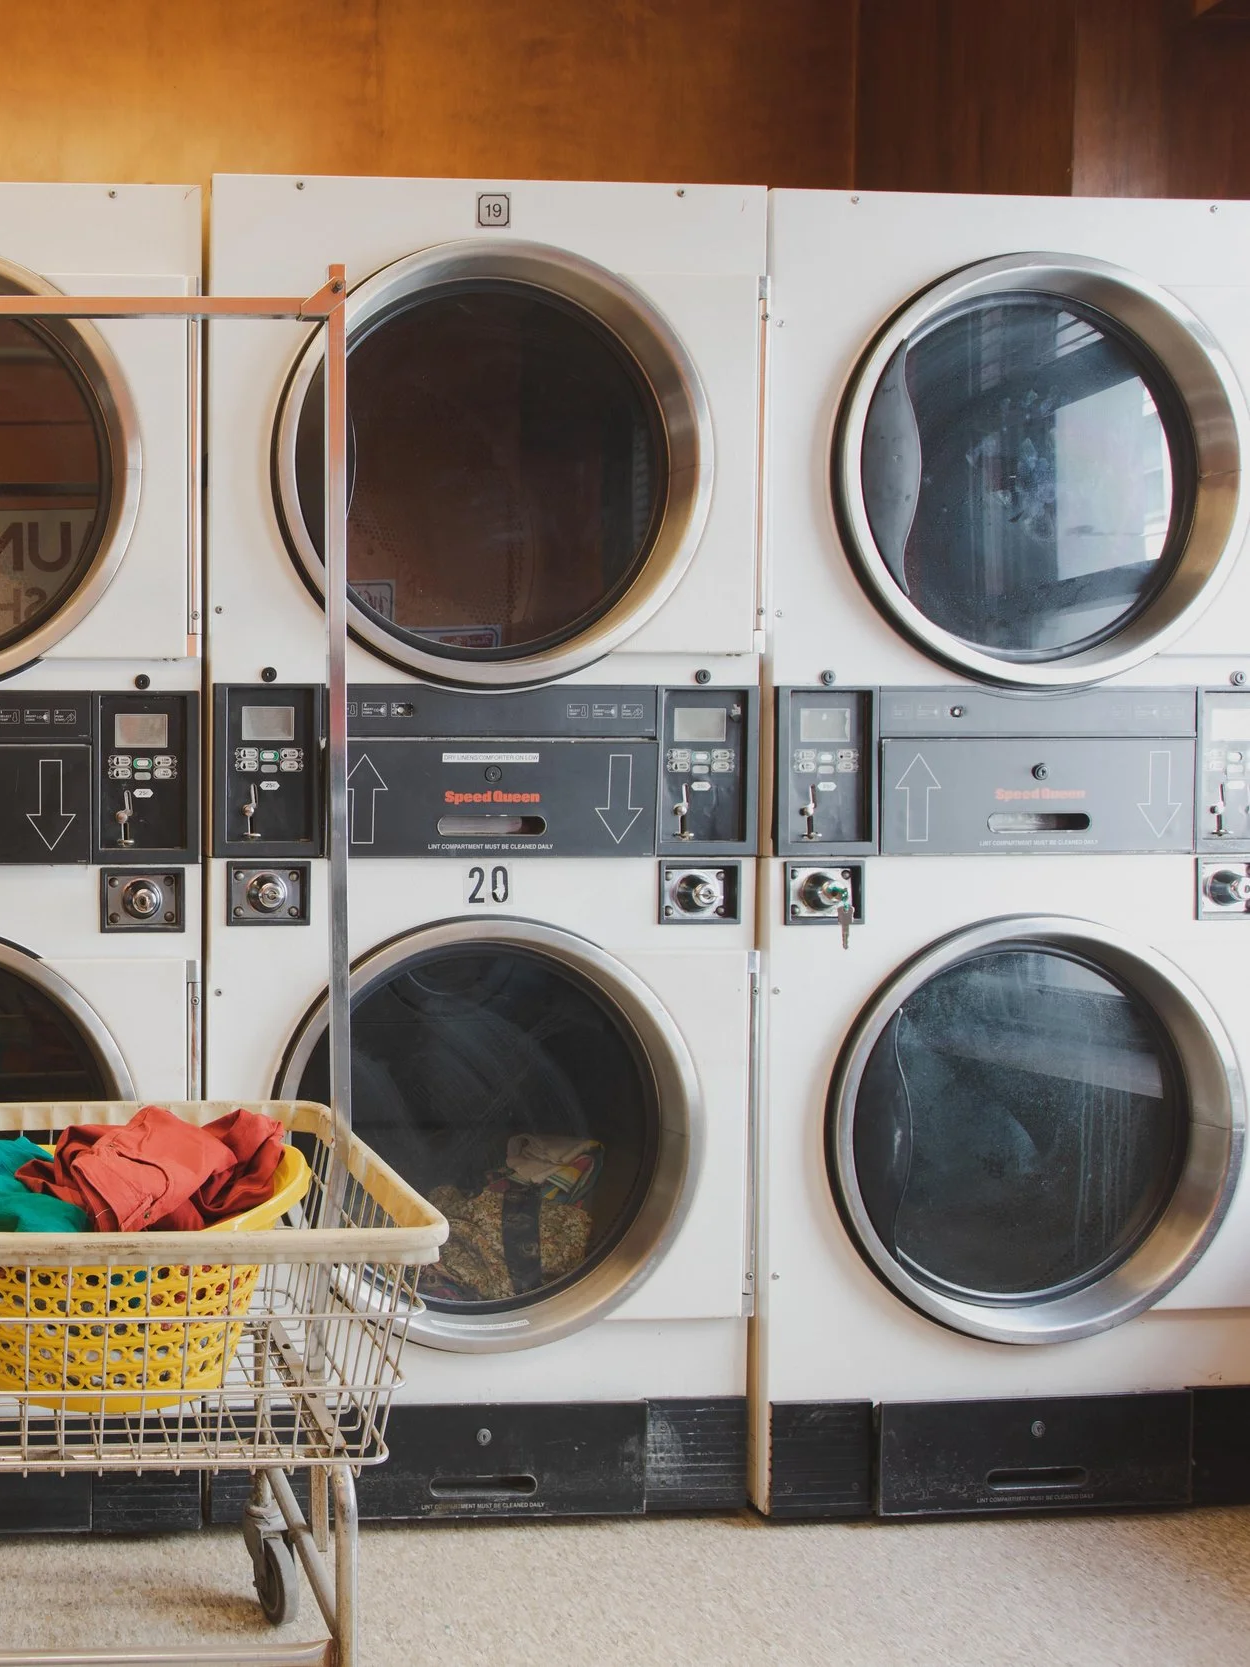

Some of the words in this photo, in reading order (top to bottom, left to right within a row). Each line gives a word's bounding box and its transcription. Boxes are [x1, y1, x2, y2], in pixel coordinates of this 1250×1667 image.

[485, 203, 502, 218] 19
[445, 790, 492, 805] Speed
[493, 790, 541, 802] Queen
[468, 865, 509, 903] 20
